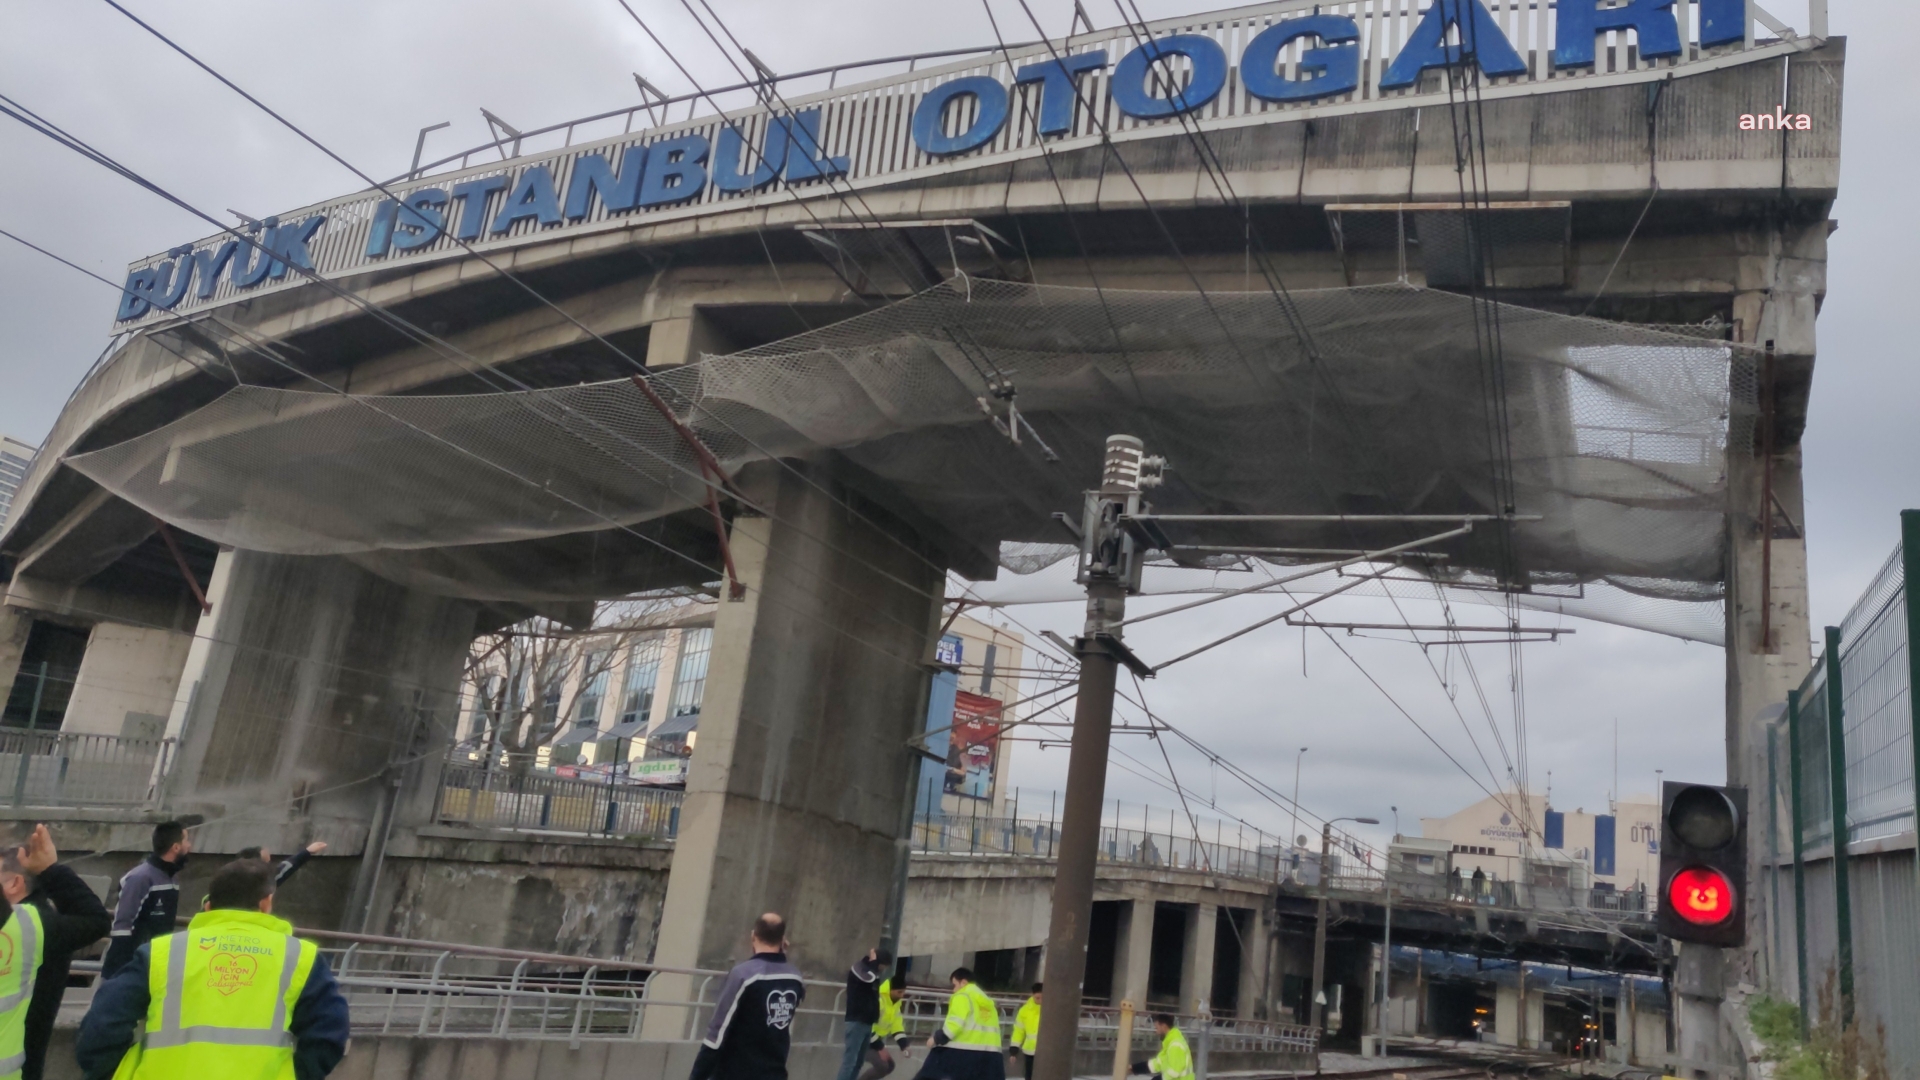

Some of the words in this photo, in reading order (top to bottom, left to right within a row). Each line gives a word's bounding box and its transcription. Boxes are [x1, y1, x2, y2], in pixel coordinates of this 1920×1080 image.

[116, 215, 327, 322] BÜYÜK
[219, 935, 261, 945] METRO
[229, 960, 238, 968] 16
